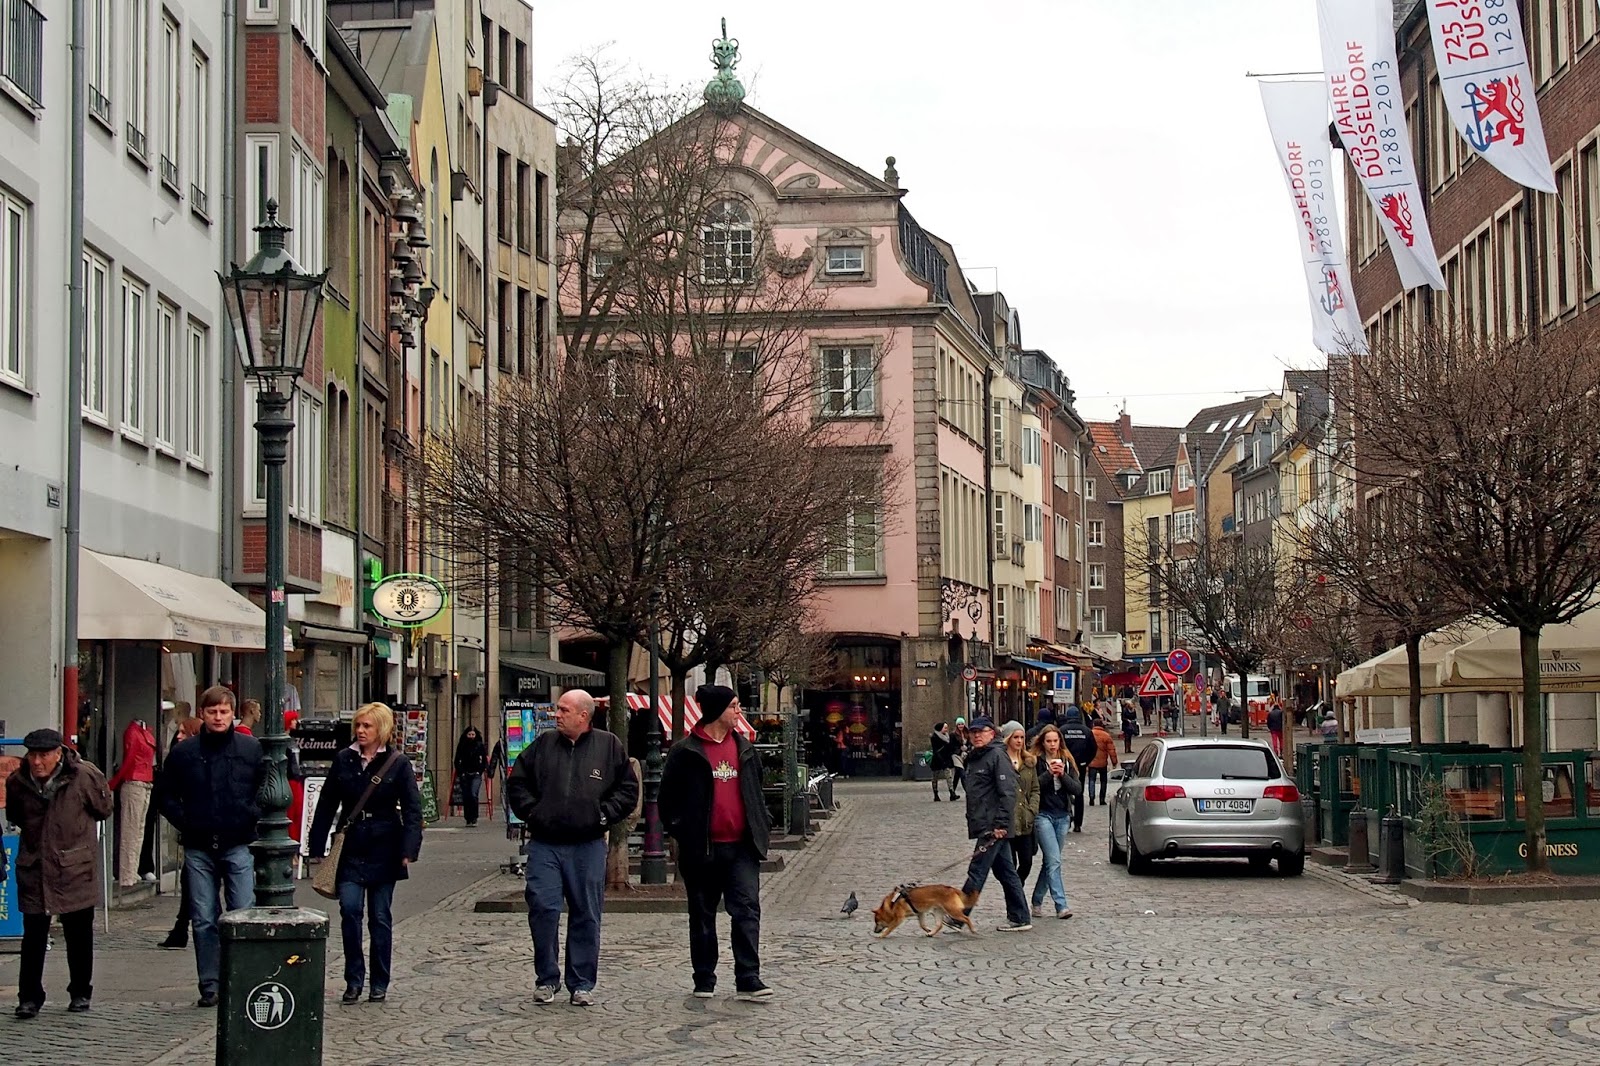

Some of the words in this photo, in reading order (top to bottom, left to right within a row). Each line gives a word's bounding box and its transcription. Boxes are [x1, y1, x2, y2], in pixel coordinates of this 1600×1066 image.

[1441, 22, 1468, 64] 725
[1331, 74, 1358, 135] JAHRE
[1346, 41, 1384, 177] DÜSSELDORF
[1540, 661, 1581, 673] UINNESS
[518, 674, 541, 694] pesch
[295, 737, 338, 750] Heimat
[712, 769, 738, 778] maple
[1205, 801, 1211, 809] D
[1228, 801, 1249, 809] 4084
